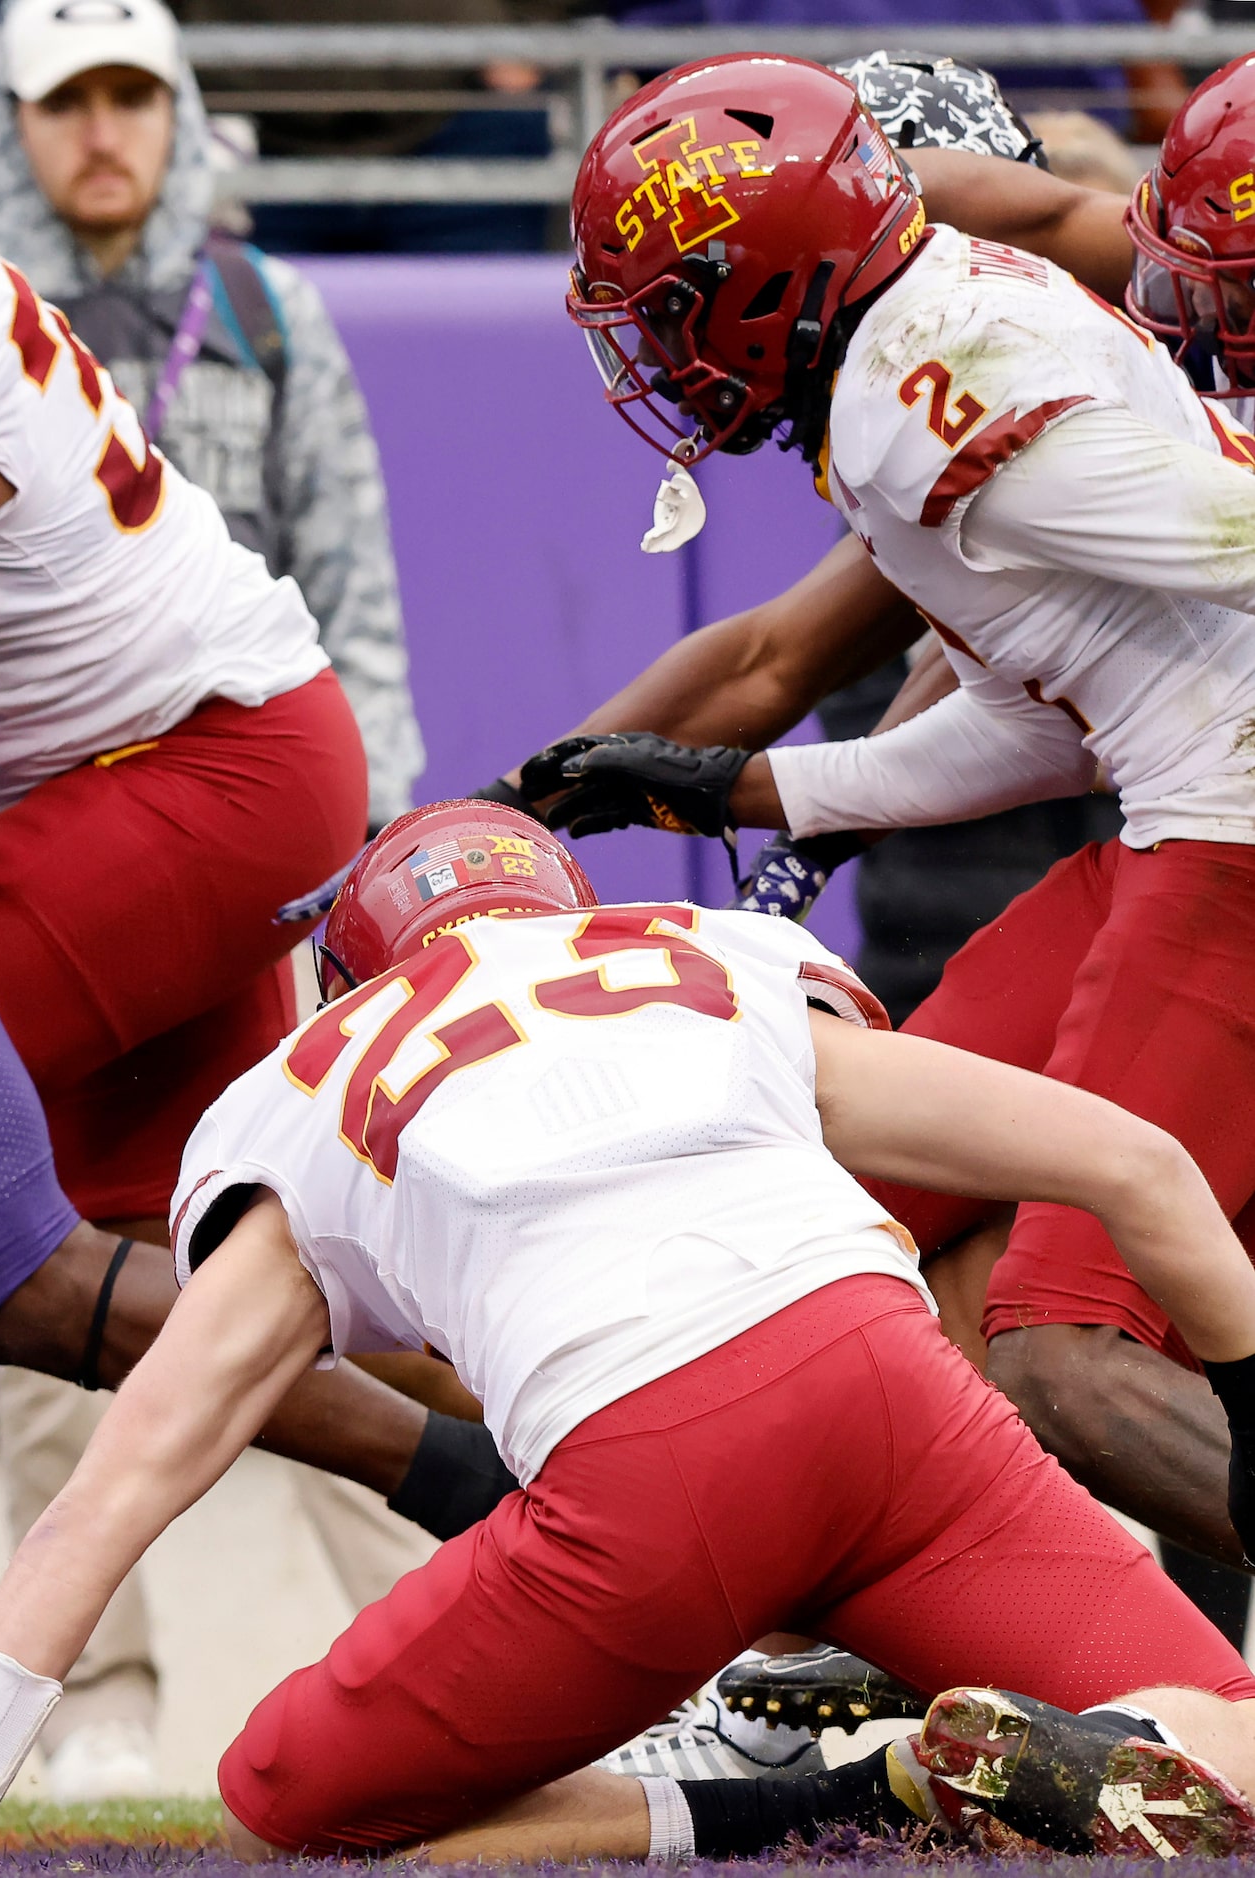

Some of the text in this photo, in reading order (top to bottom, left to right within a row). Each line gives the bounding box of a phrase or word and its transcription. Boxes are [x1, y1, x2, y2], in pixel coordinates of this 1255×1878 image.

[615, 140, 775, 253] STATE
[897, 358, 989, 452] 2
[501, 856, 538, 877] 23
[282, 903, 743, 1188] 25
